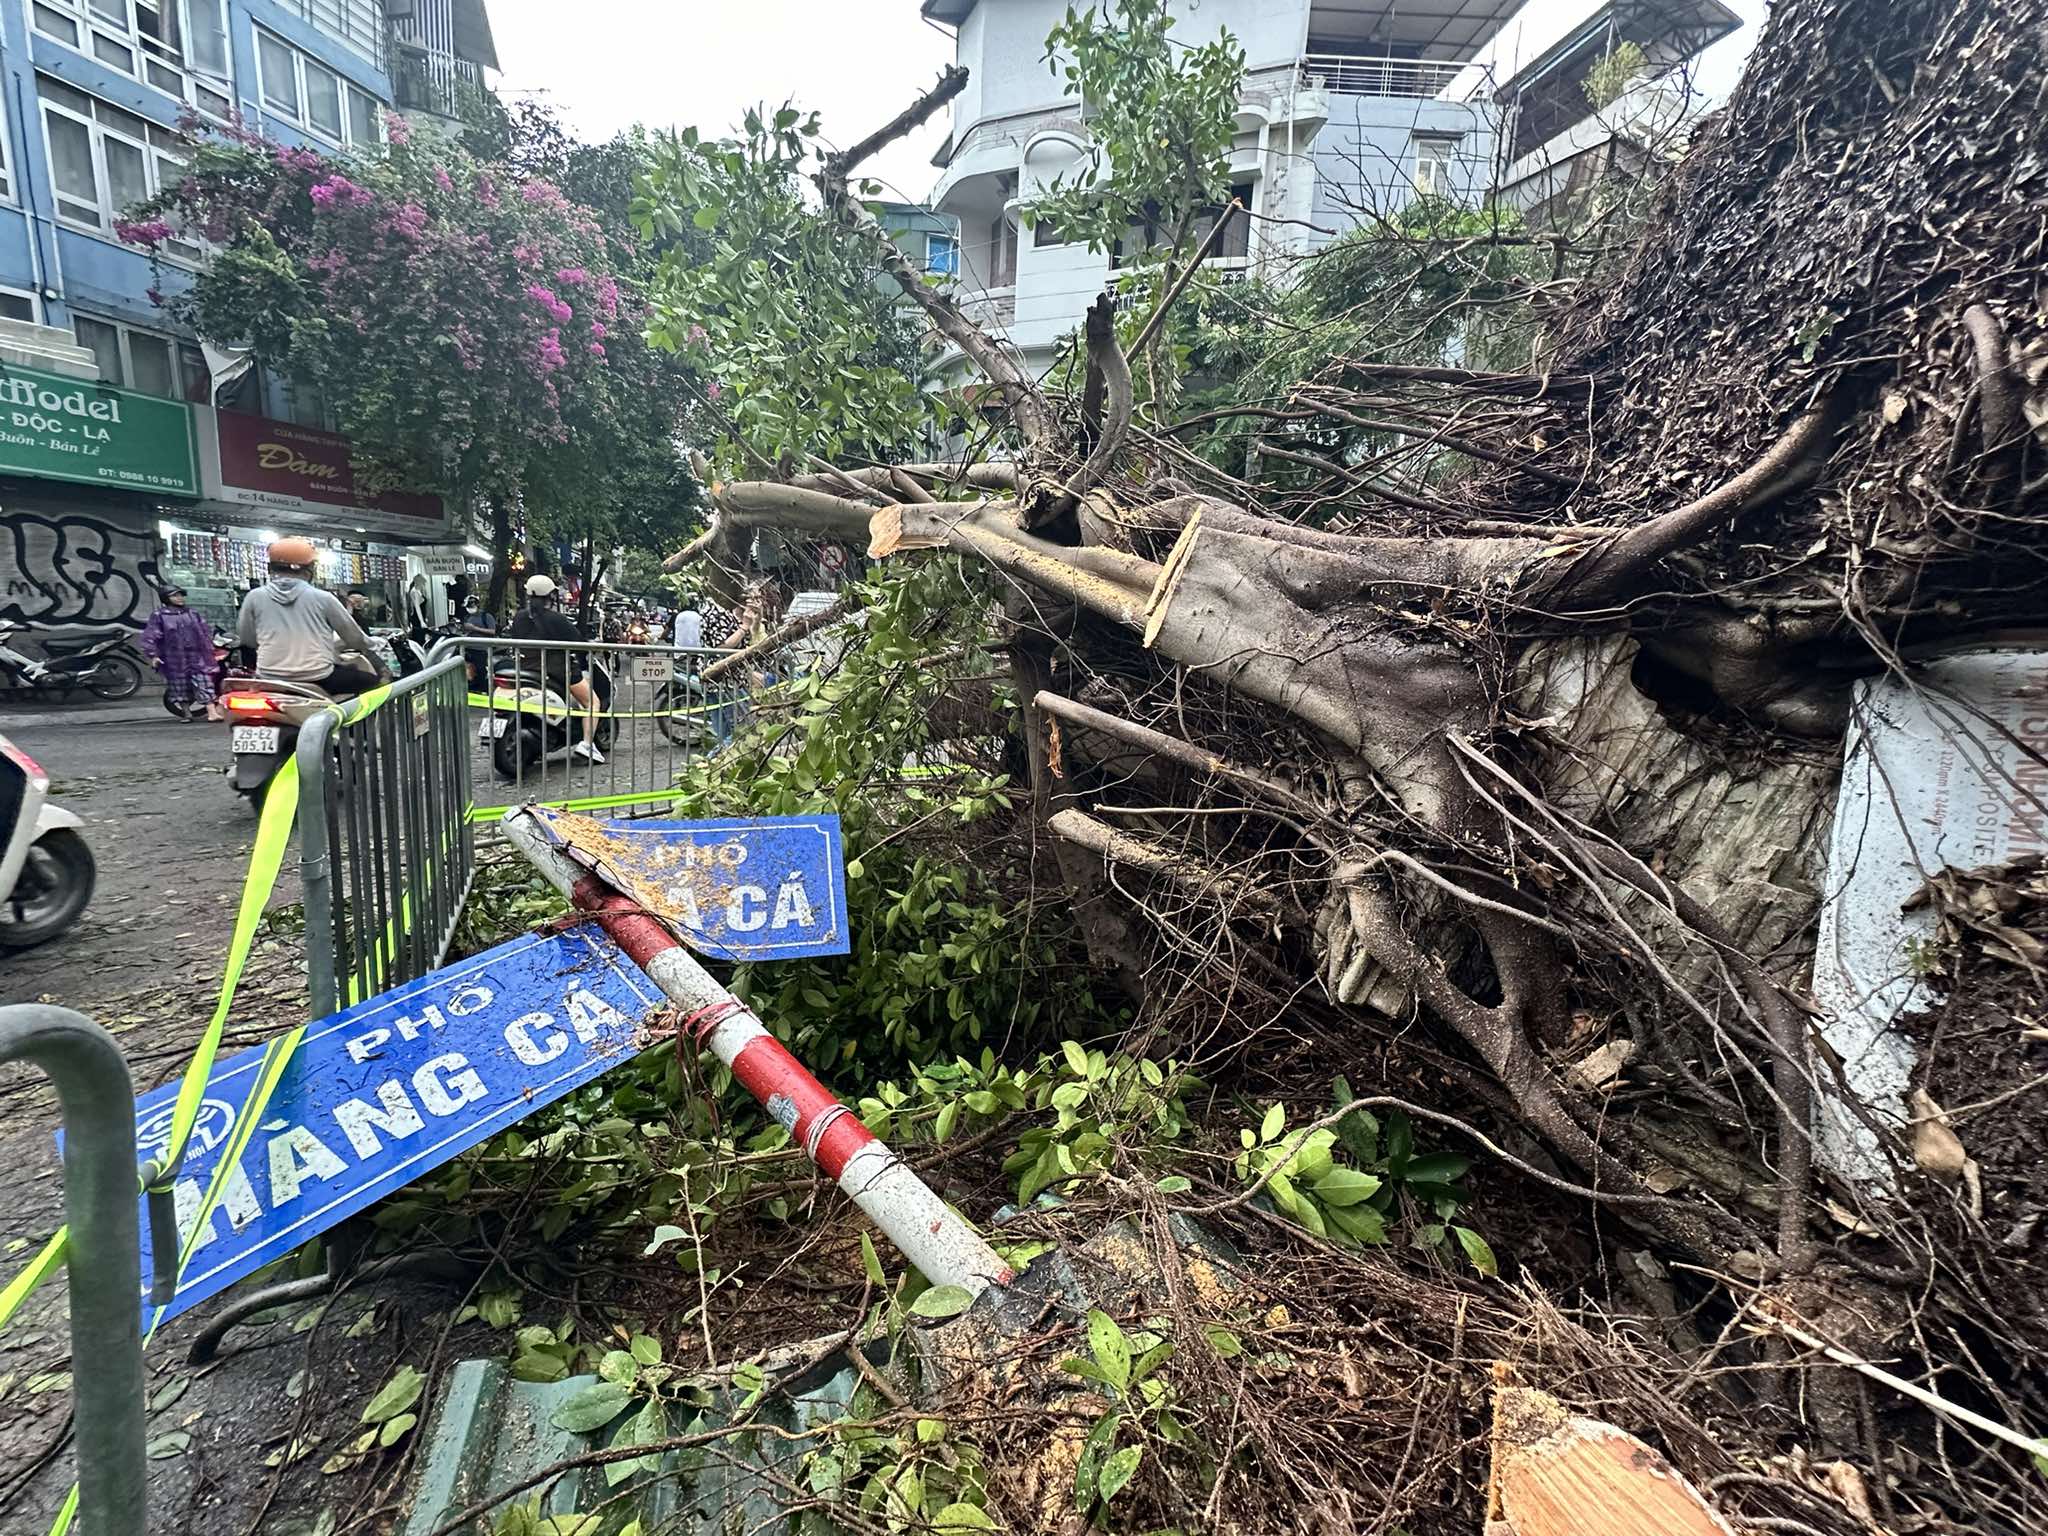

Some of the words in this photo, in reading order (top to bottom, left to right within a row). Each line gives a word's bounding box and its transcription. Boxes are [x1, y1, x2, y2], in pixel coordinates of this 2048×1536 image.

[11, 412, 63, 433] ĐỘC
[83, 424, 111, 444] LẠ
[48, 438, 79, 453] Bán
[641, 668, 666, 678] STOP
[726, 870, 816, 932] CÁ
[345, 972, 494, 1064] PHỐ
[173, 1052, 489, 1251] HÀNG
[503, 978, 628, 1066] CÁ
